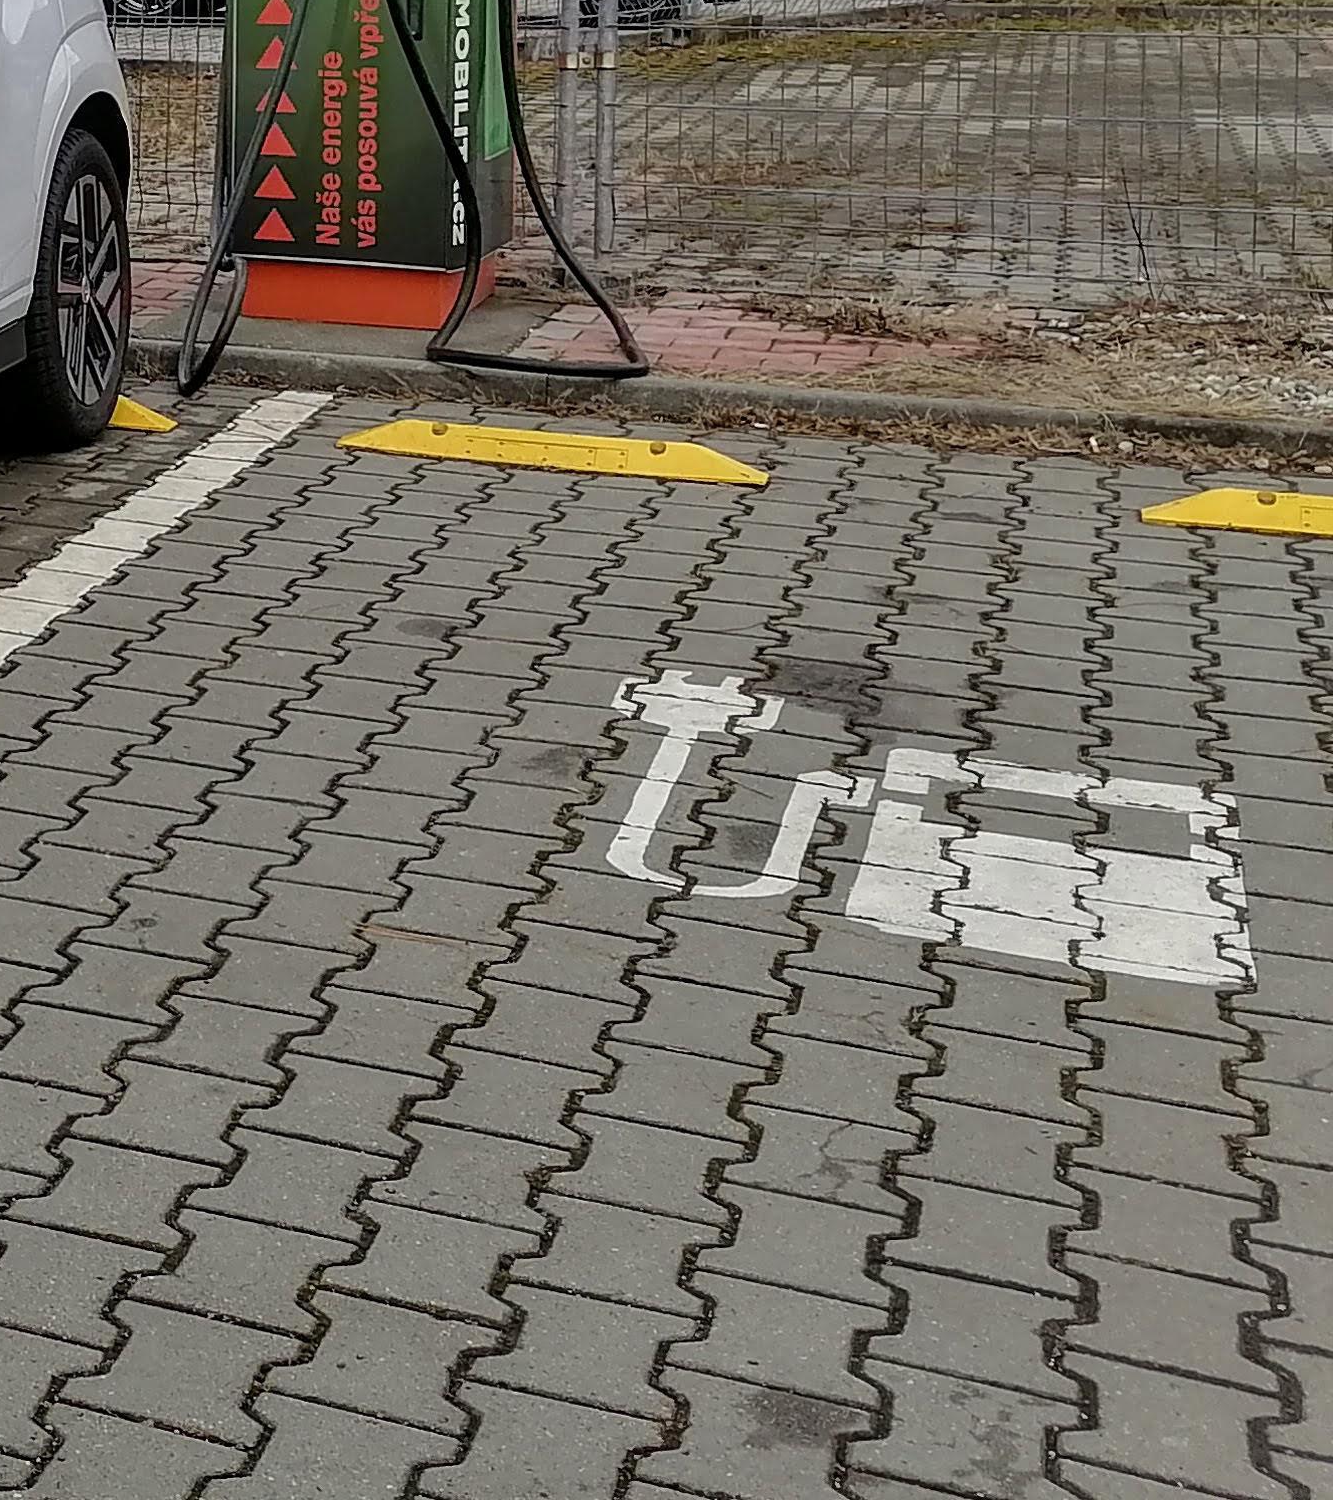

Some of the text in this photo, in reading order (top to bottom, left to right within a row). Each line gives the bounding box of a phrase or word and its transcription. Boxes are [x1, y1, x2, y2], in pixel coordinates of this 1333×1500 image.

[316, 51, 347, 246] Naše energie
[353, 66, 382, 192] posouvá
[351, 199, 377, 248] vás
